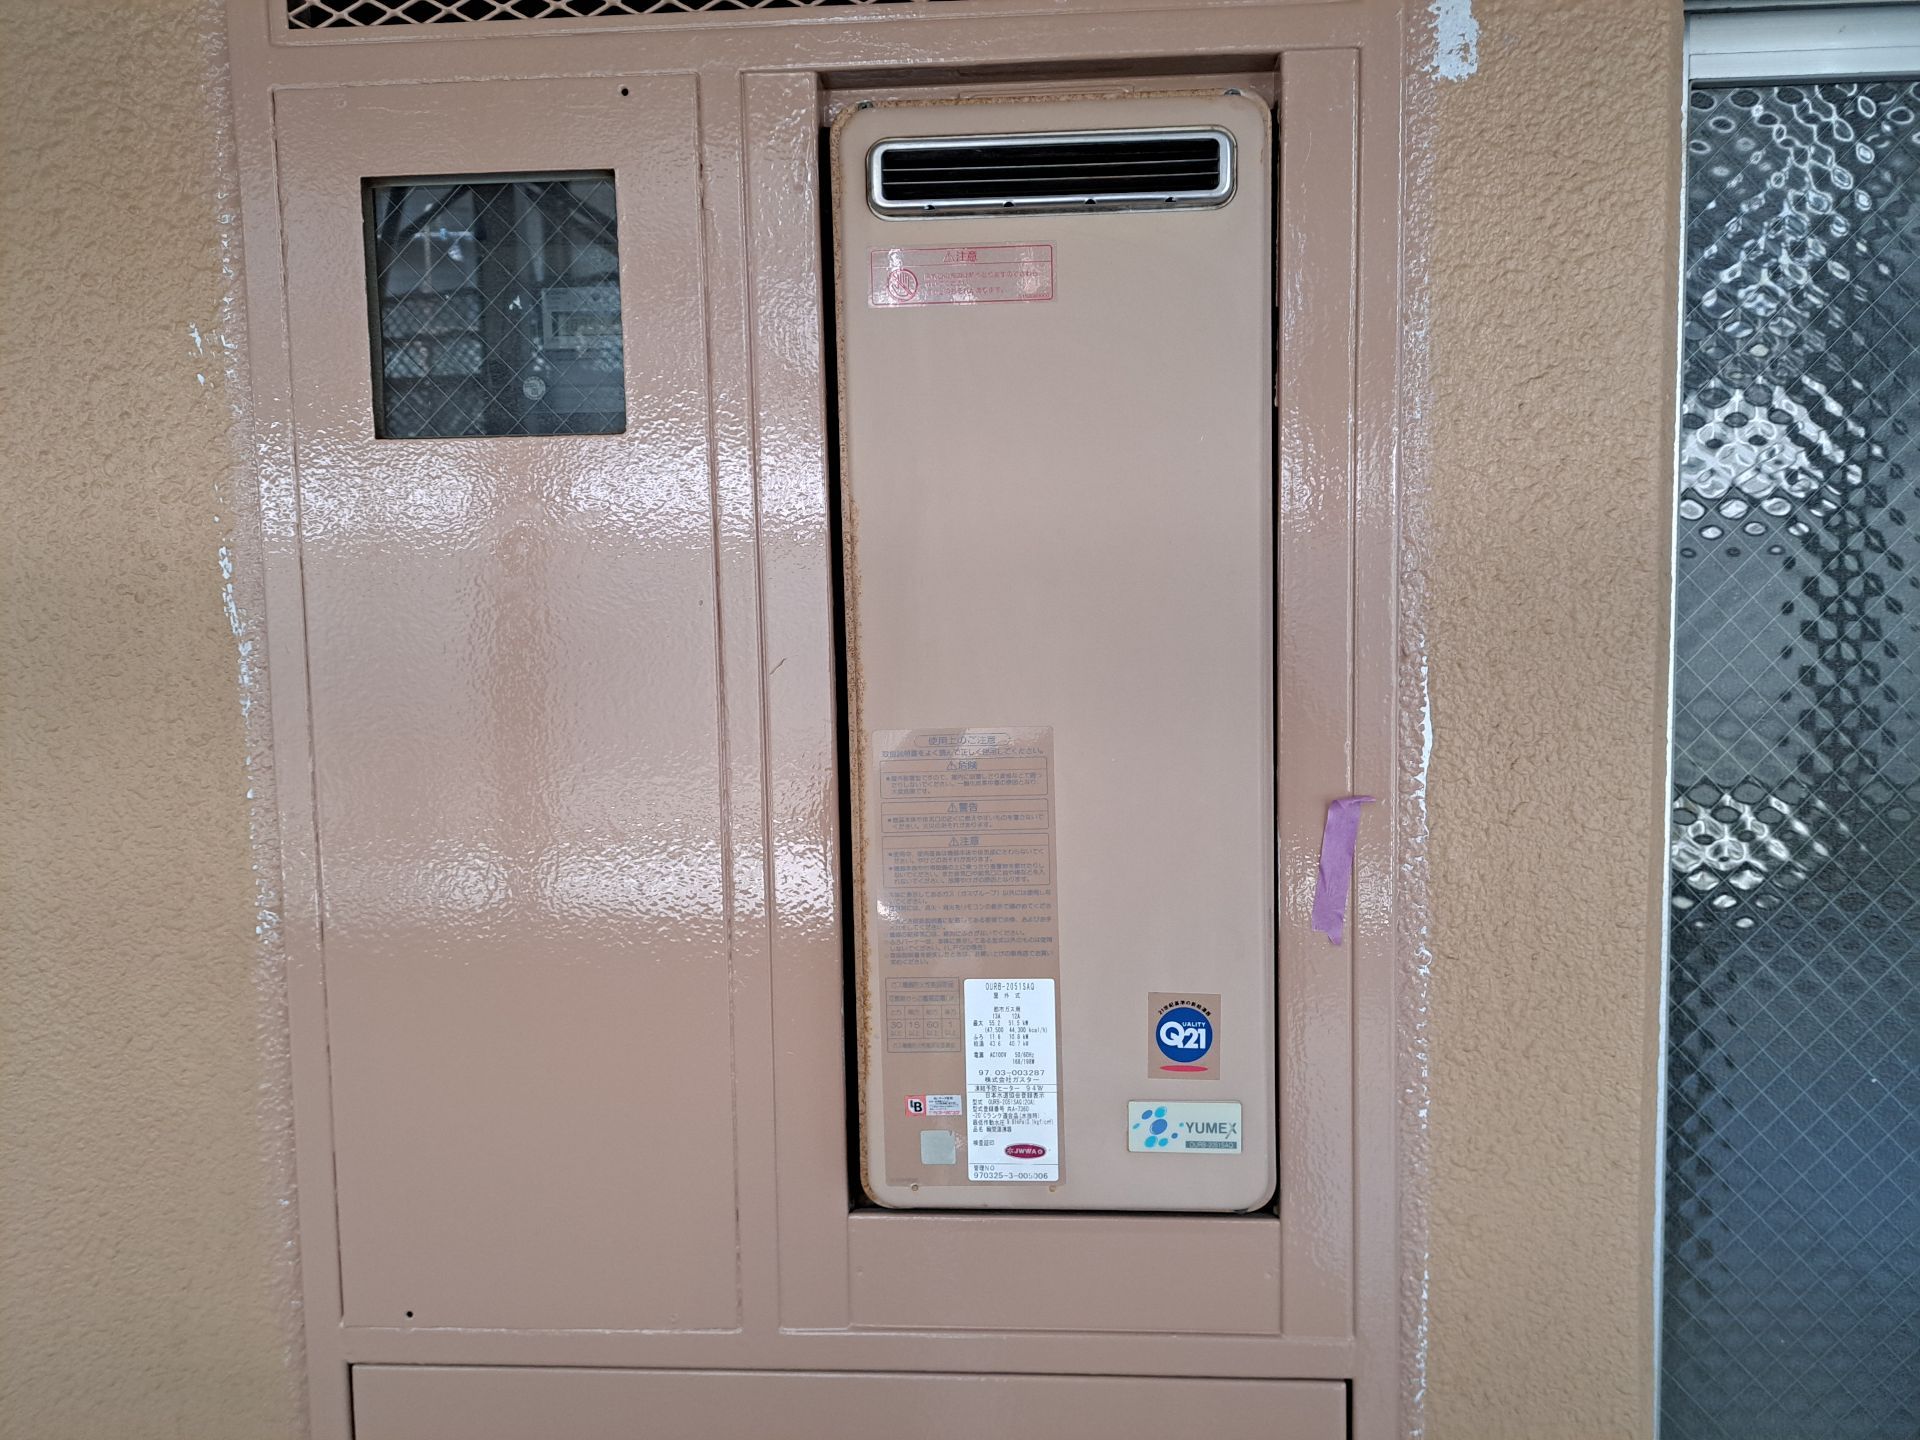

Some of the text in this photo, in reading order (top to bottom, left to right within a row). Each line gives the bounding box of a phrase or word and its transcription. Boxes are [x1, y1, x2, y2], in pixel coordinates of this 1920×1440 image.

[1160, 1021, 1206, 1049] Q21
[1185, 1122, 1238, 1139] YUMEX
[1014, 1147, 1037, 1155] JWWA
